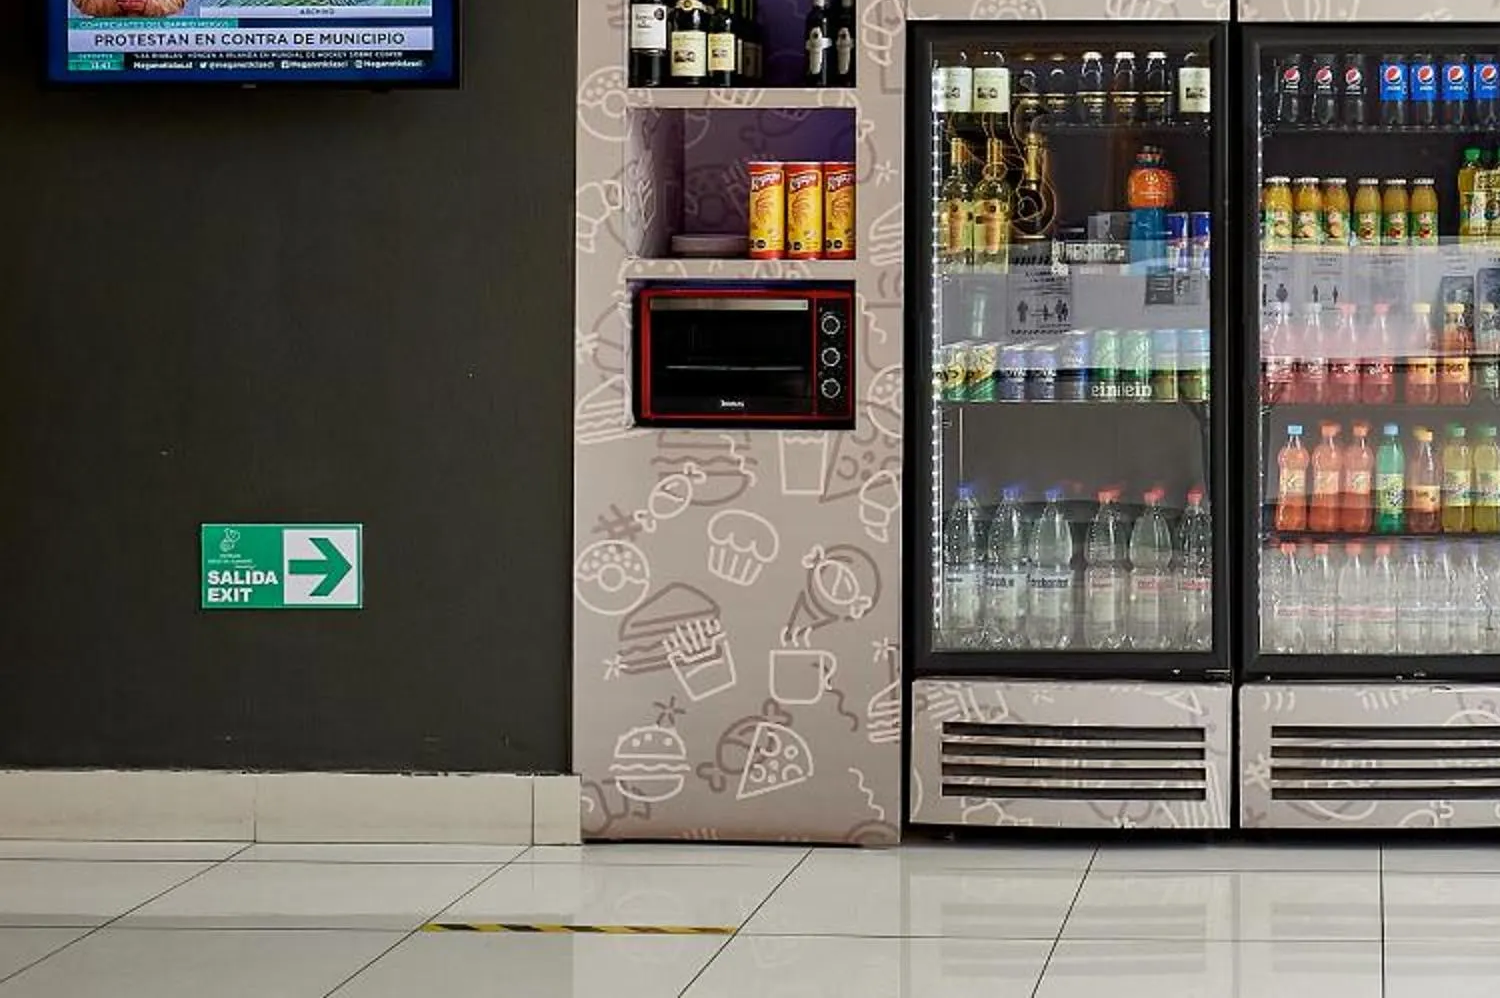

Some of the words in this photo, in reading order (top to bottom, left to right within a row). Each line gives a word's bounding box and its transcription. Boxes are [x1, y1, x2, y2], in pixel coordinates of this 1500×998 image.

[94, 33, 189, 47] PROTESTAN
[195, 33, 216, 46] EN
[221, 33, 288, 46] CONTRA
[293, 33, 315, 45] DE
[319, 32, 405, 45] MUNICIPIO
[207, 569, 279, 586] SALIDA
[207, 587, 254, 603] EXIT
